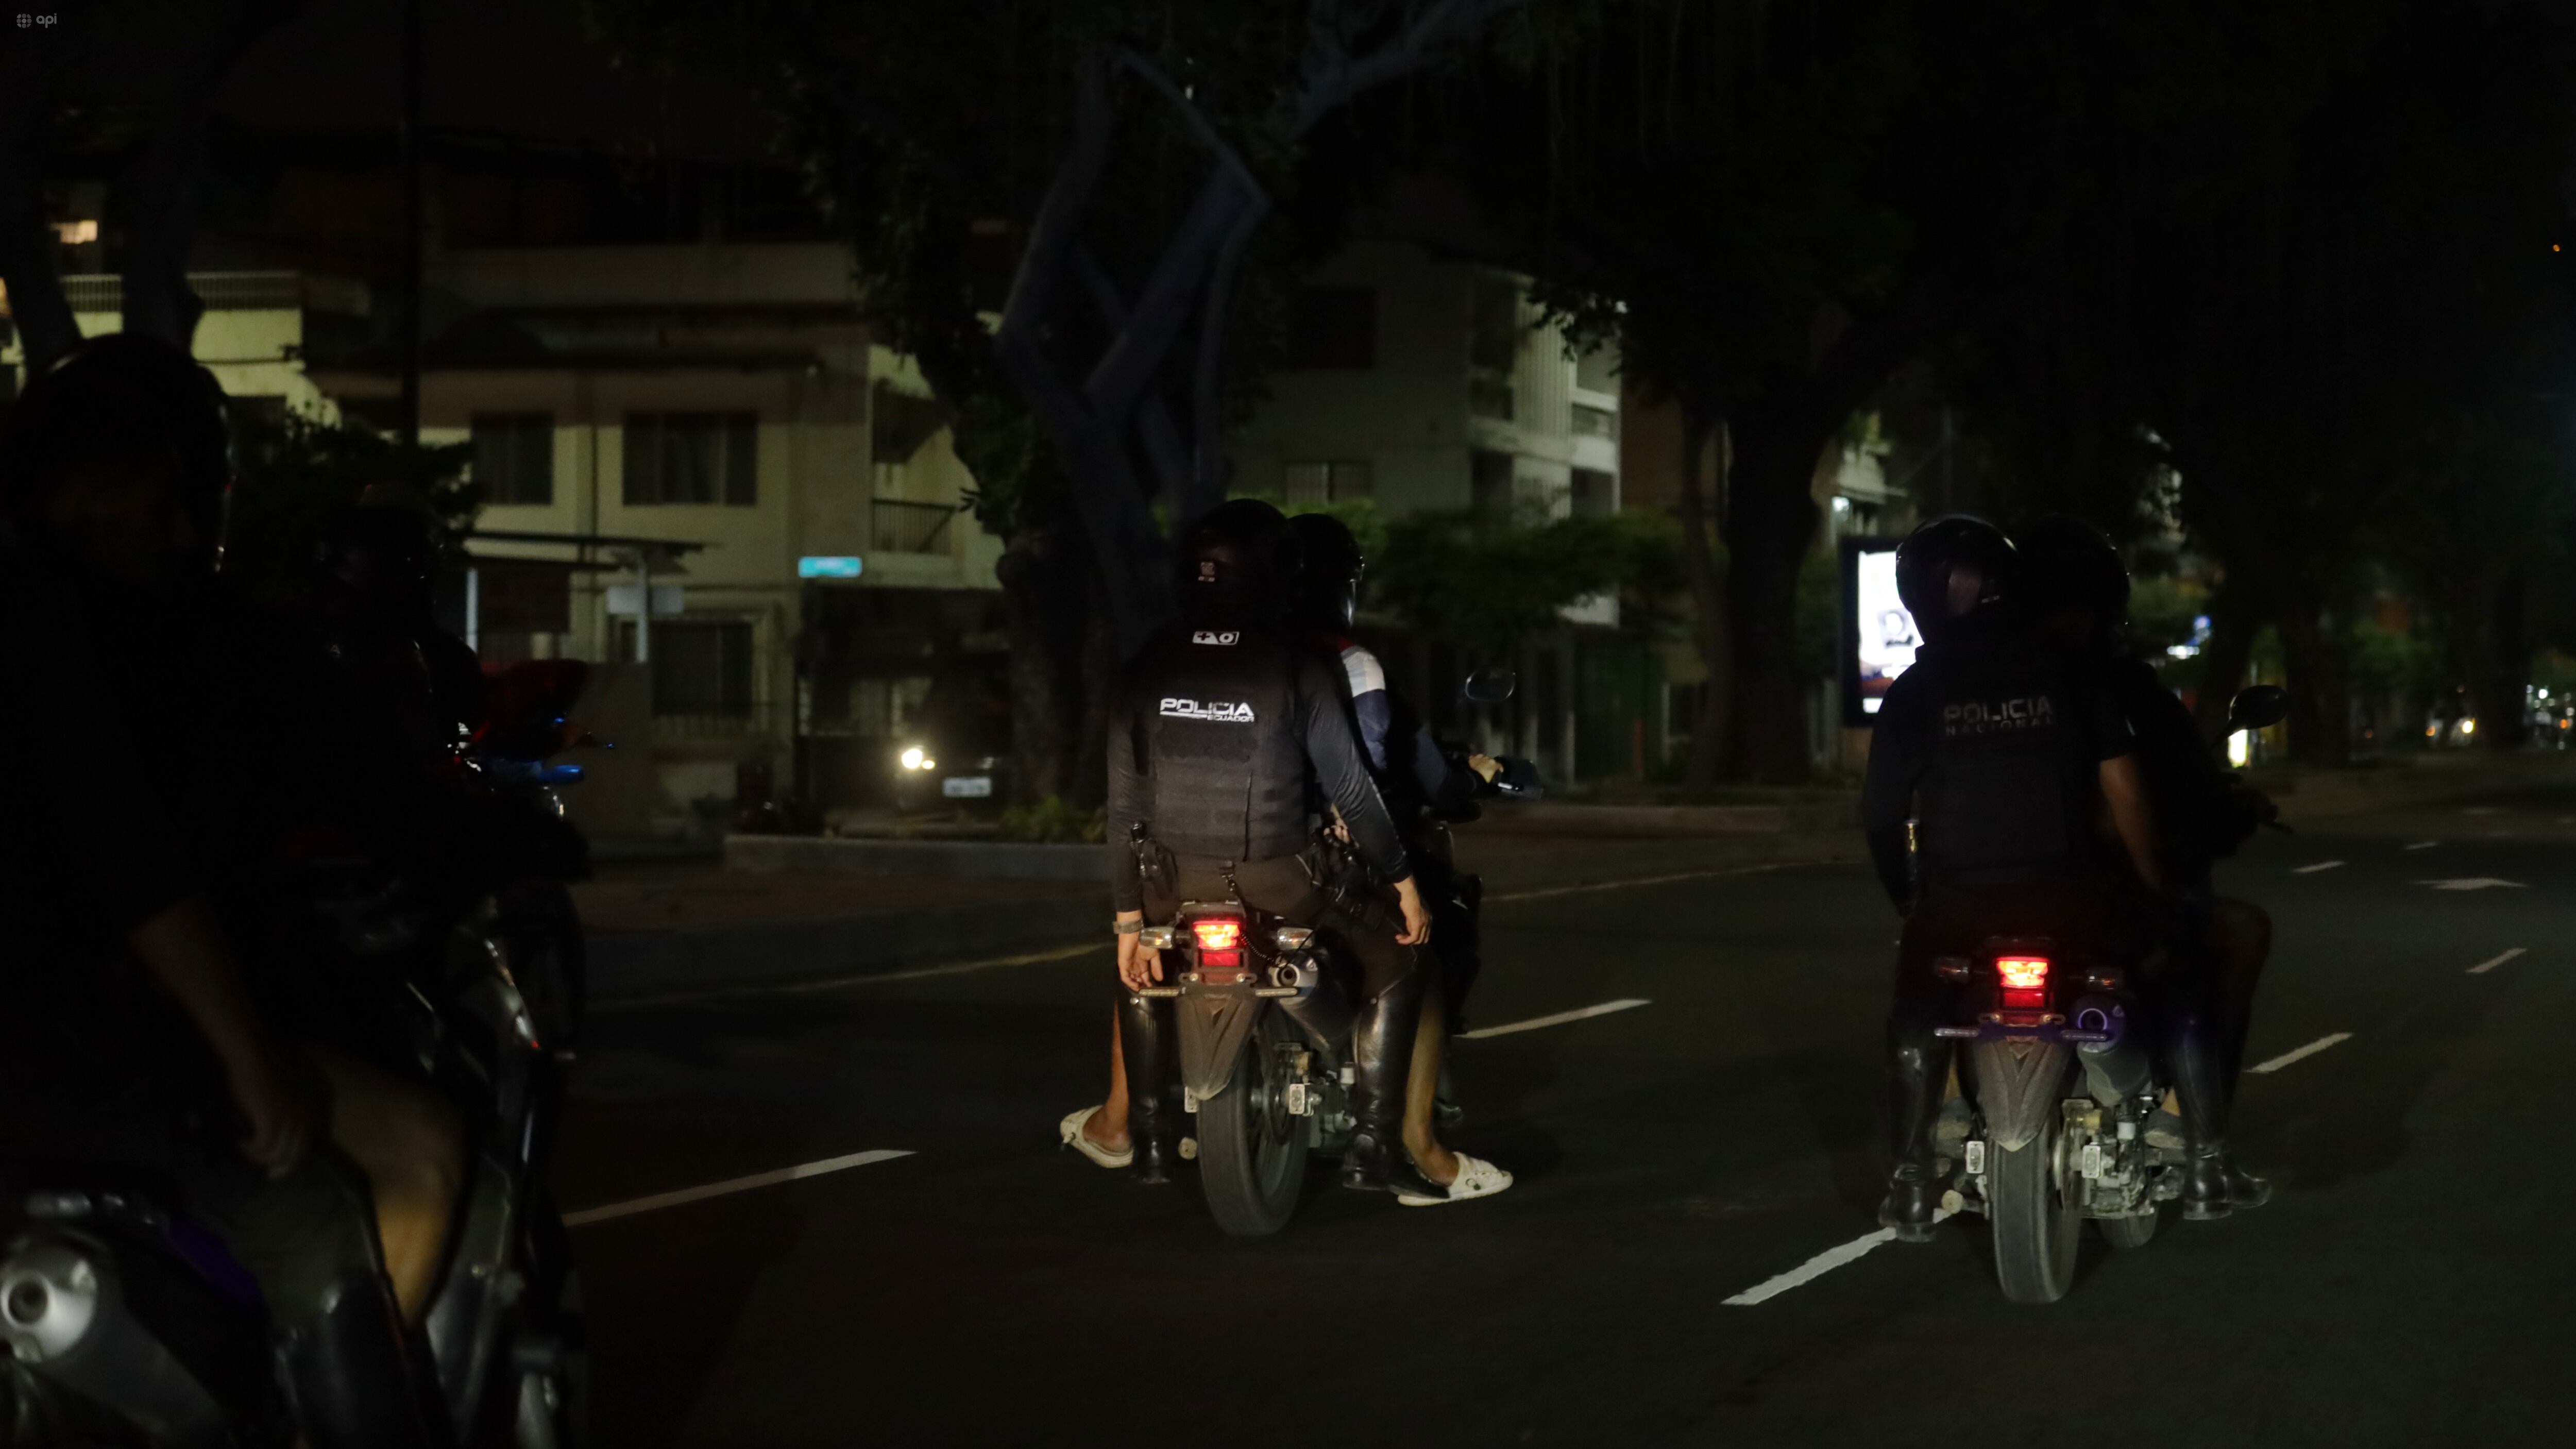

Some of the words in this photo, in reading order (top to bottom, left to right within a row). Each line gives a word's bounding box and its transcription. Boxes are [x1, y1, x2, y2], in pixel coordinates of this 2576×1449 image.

[1160, 698, 1255, 716] POLICIA
[1944, 696, 2053, 722] POLICIA
[1207, 714, 1255, 722] ECUADOR
[1945, 715, 2053, 736] NACIONAL
